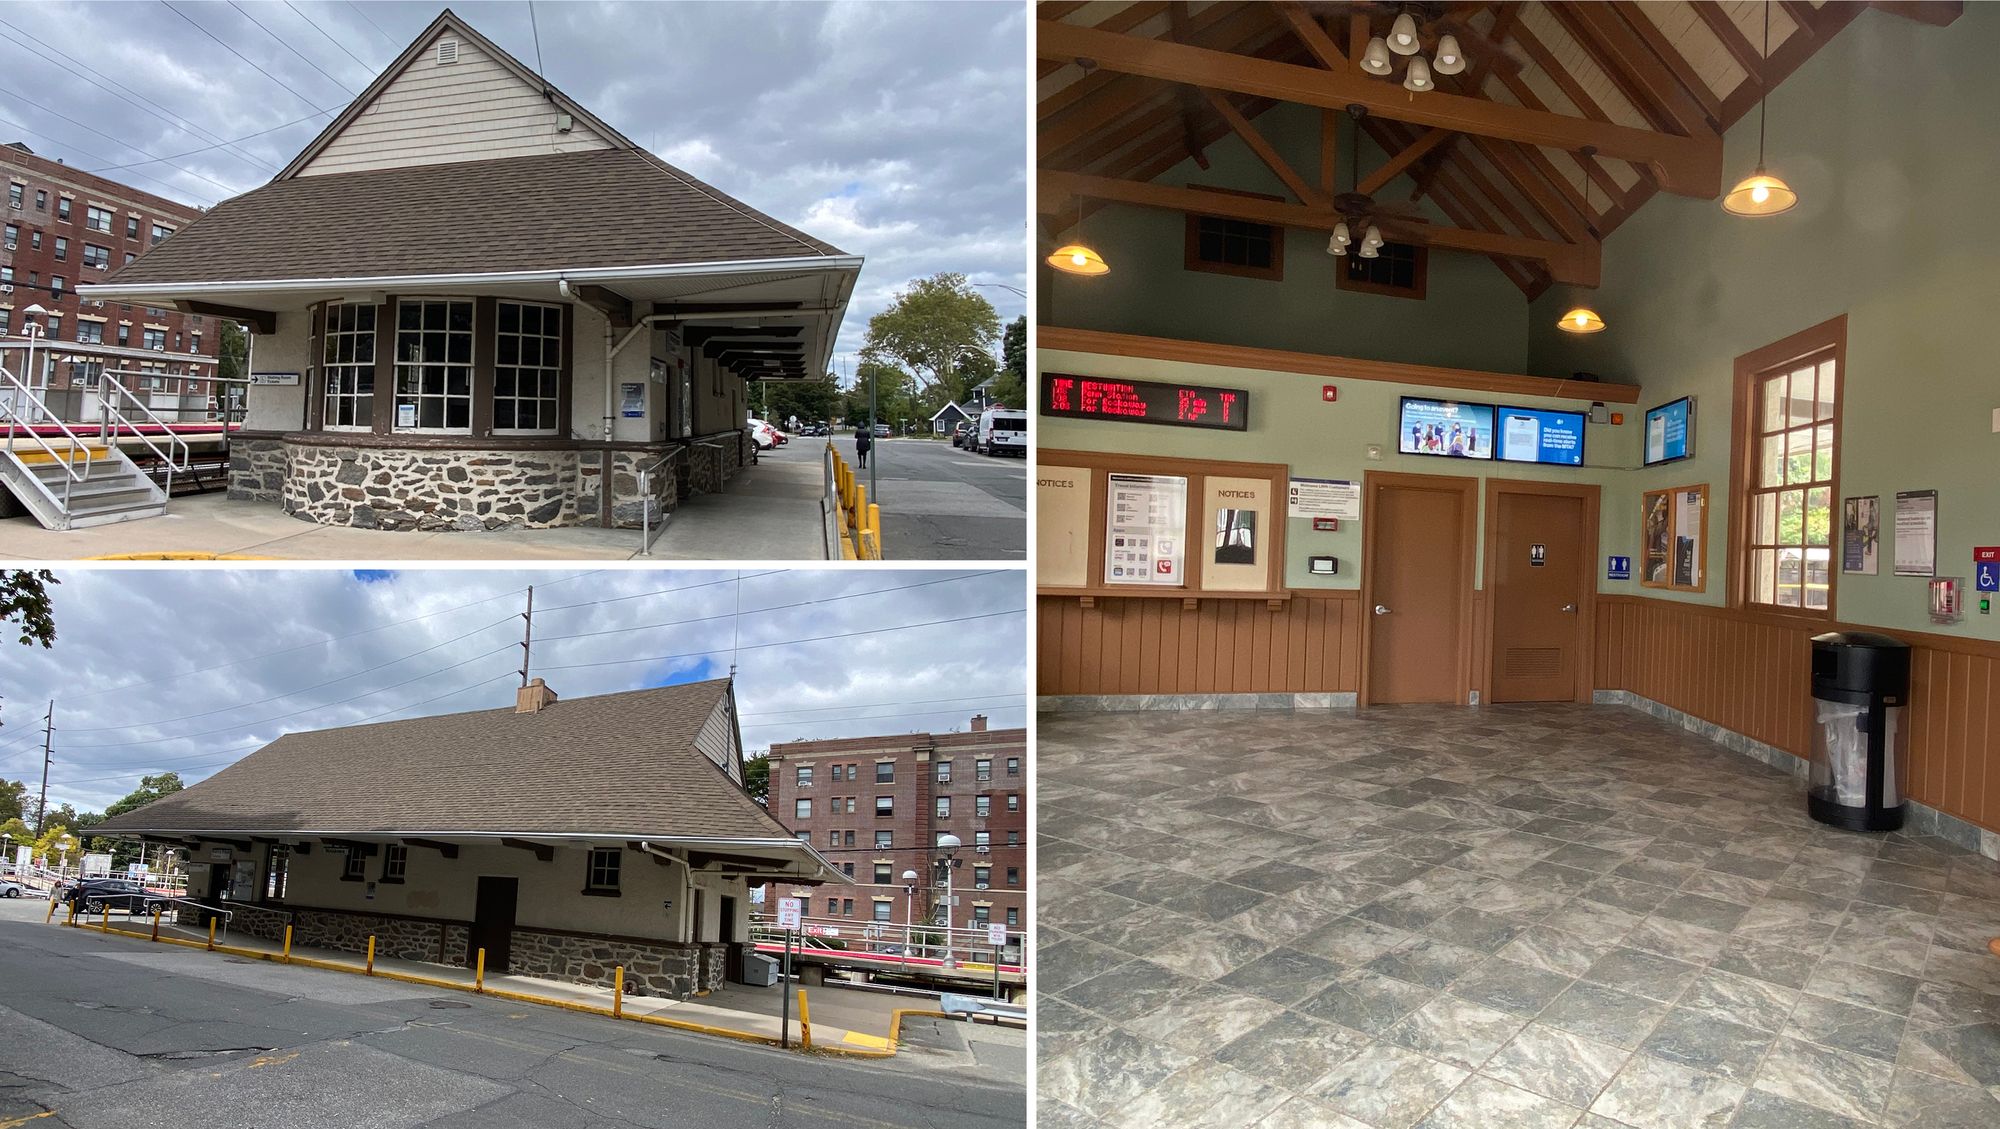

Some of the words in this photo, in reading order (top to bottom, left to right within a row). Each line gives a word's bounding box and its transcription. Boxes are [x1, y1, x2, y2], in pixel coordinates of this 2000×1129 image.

[1102, 405, 1147, 416] Rockaway
[1405, 402, 1424, 411] Going
[1218, 490, 1255, 499] NOTICES
[808, 926, 823, 934] Exit
